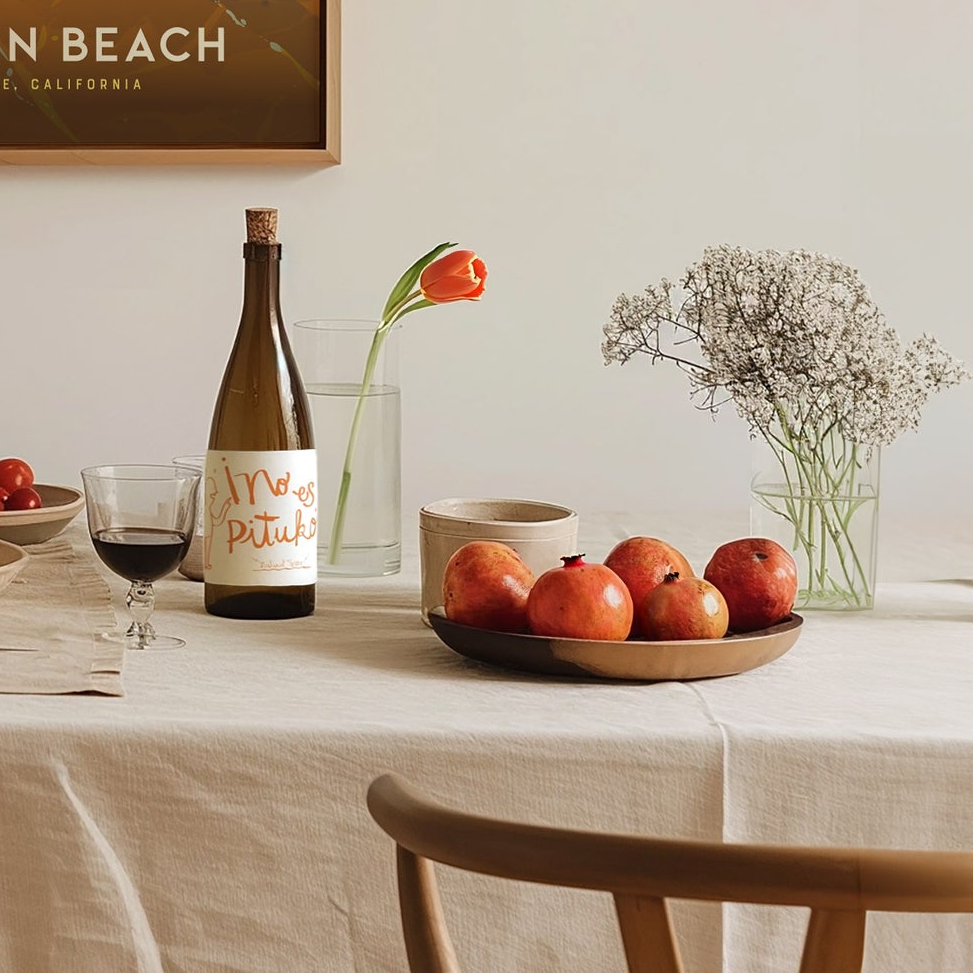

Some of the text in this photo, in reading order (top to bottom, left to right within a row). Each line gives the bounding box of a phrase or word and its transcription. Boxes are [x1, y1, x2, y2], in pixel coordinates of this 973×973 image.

[62, 26, 226, 63] BEACH
[30, 77, 143, 91] CALIFORNIA
[292, 481, 315, 508] es
